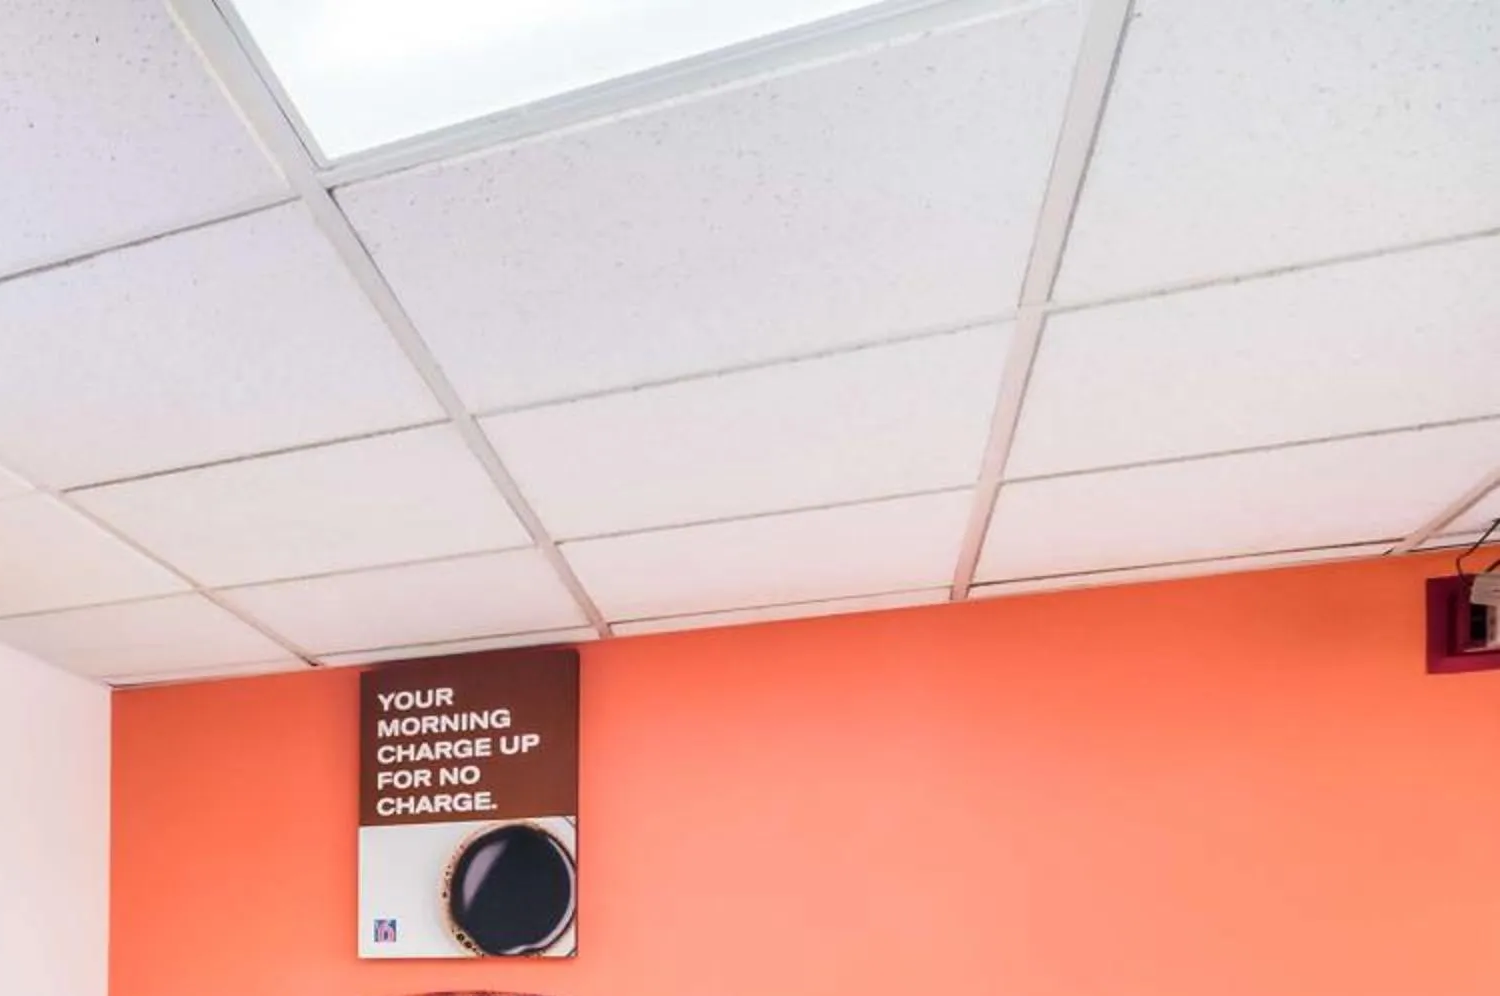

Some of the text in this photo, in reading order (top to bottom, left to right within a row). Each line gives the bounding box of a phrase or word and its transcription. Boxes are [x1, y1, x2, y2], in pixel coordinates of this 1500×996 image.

[378, 687, 454, 711] YOUR
[377, 709, 511, 738] MORNING
[377, 733, 541, 765] CHARGE UP
[377, 766, 481, 790] FOR NO
[377, 792, 498, 817] CHARGE.
